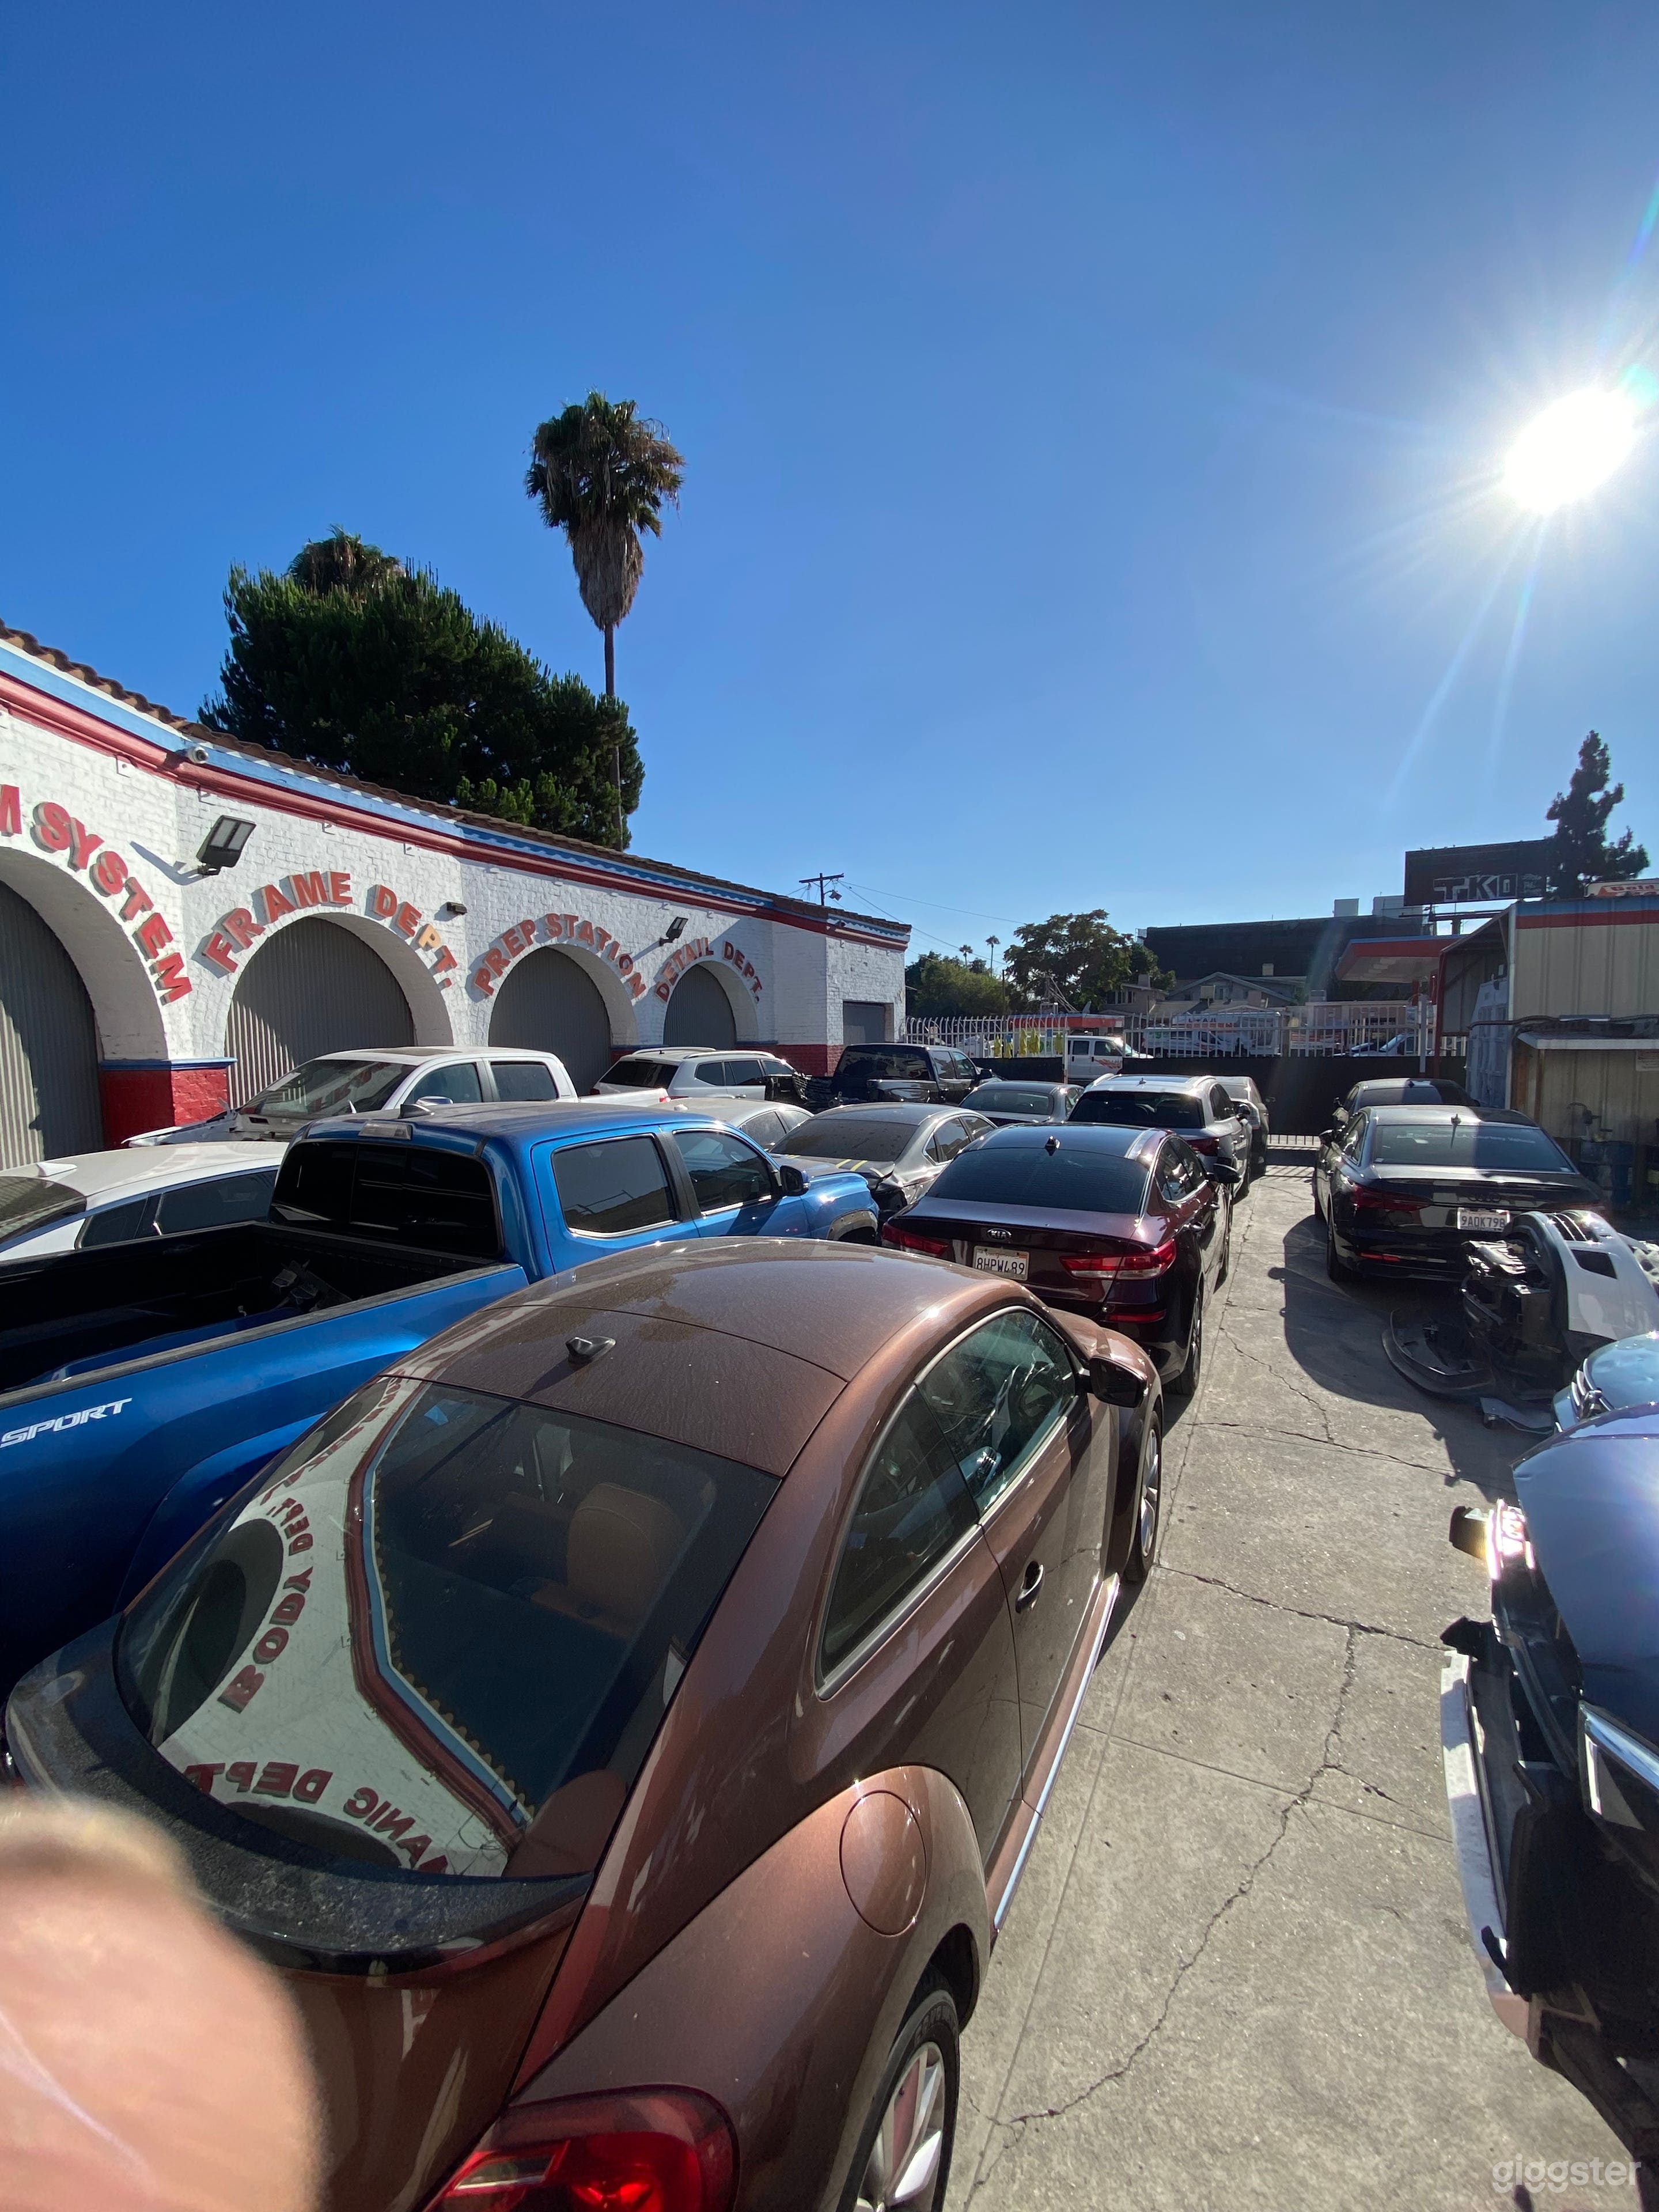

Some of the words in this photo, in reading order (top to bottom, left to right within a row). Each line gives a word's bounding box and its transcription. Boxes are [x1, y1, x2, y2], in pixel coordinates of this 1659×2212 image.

[30, 802, 192, 1005] SYSTEM
[202, 870, 354, 975] FRAME
[474, 918, 537, 997] PREP
[544, 914, 647, 1002] STATION
[654, 937, 714, 1002] DETAIL
[0, 1397, 132, 1448] SPORT
